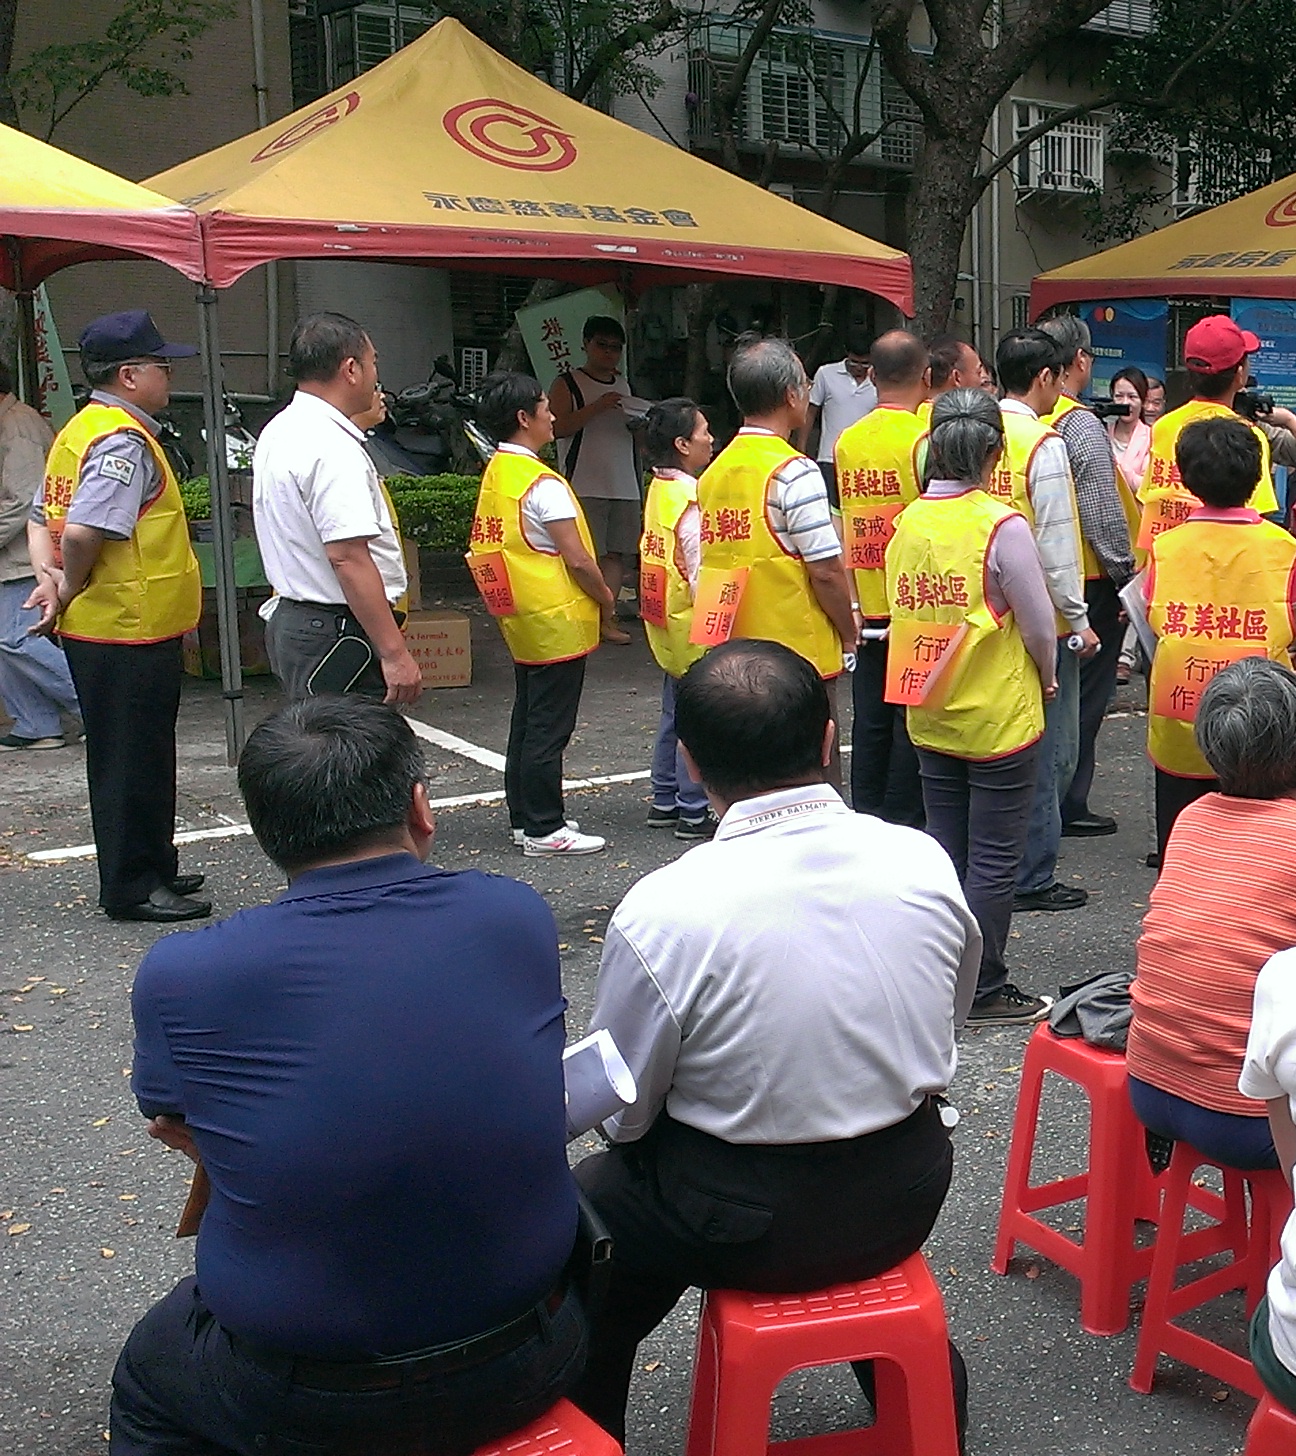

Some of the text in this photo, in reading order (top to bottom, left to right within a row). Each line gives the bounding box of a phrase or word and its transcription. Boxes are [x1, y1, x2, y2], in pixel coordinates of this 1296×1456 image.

[853, 514, 888, 538] 警戒
[850, 541, 887, 564] 技術
[894, 571, 969, 611] 萬美社區
[1161, 600, 1269, 642] 萬美社區
[748, 802, 829, 826] PIERRE BALMAIN
